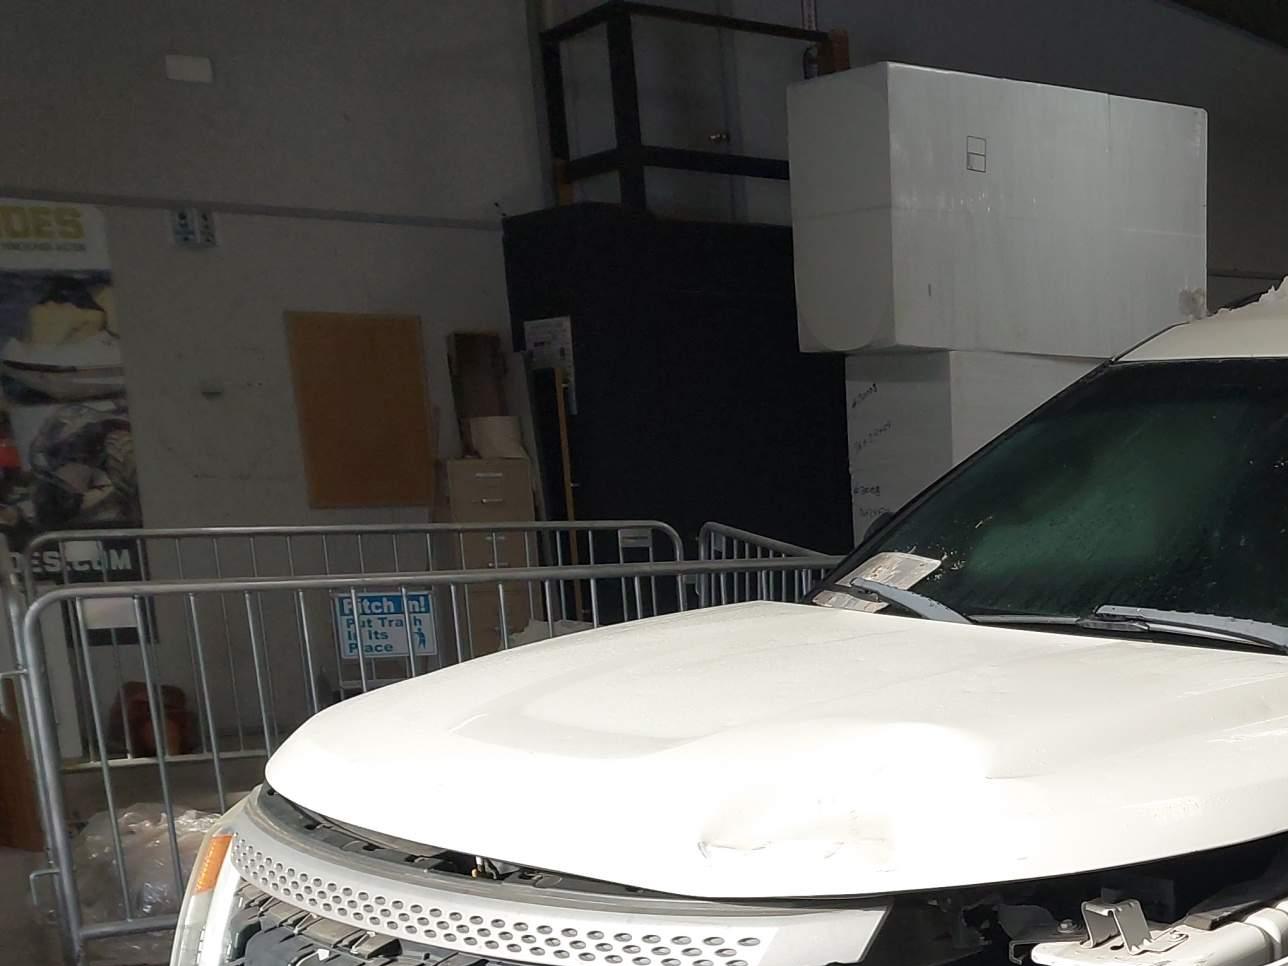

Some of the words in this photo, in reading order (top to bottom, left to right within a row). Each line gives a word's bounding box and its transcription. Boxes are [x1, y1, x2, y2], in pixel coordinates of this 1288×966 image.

[400, 595, 426, 613] n!
[377, 616, 422, 628] Trah
[368, 630, 389, 641] Its
[349, 643, 394, 654] Pace
